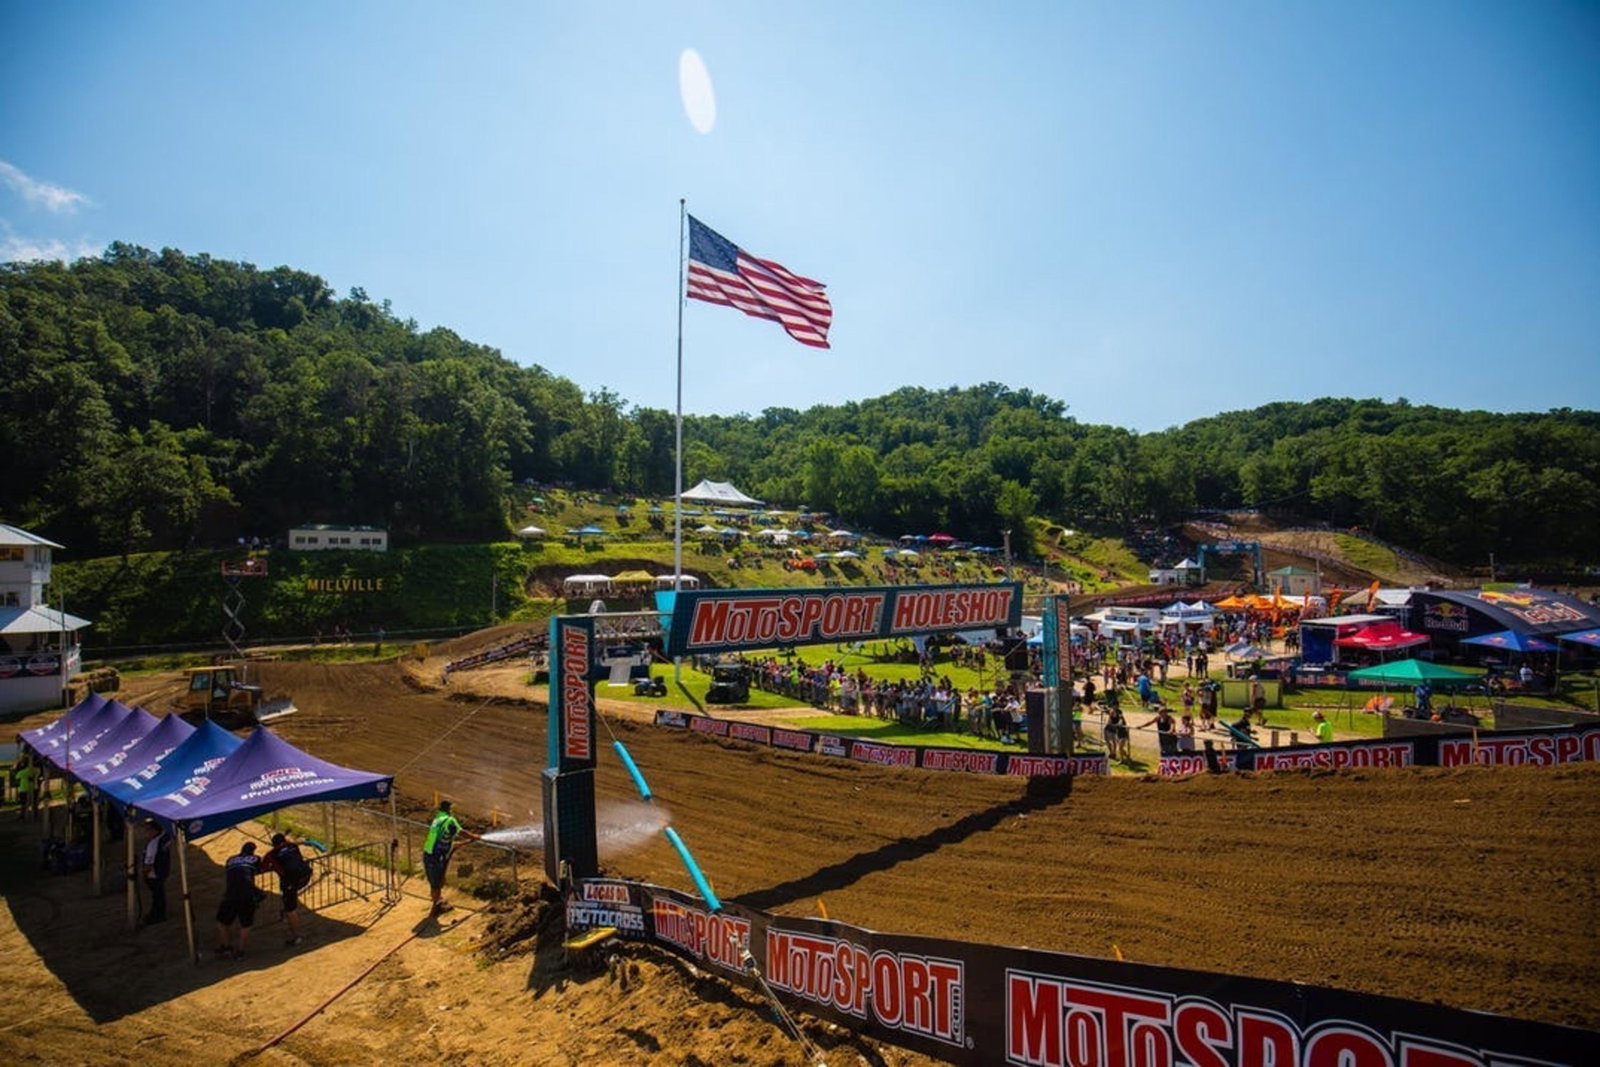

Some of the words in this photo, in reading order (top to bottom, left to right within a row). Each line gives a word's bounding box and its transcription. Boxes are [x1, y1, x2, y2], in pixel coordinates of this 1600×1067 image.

[307, 578, 384, 592] MILLVILLE
[691, 595, 882, 645] MOTOSPORT
[893, 589, 1012, 630] HOLESHOT
[564, 627, 589, 757] MOTOSPORT
[853, 743, 914, 767] MOTOSPORT
[923, 751, 996, 773] MOTOSPORT
[1257, 746, 1410, 770] MOTOSPORT
[240, 777, 335, 801] #ProMotocross
[585, 885, 616, 901] LUCAS
[569, 907, 645, 931] MOTOCROSS
[768, 931, 959, 1036] MOTOSPORT
